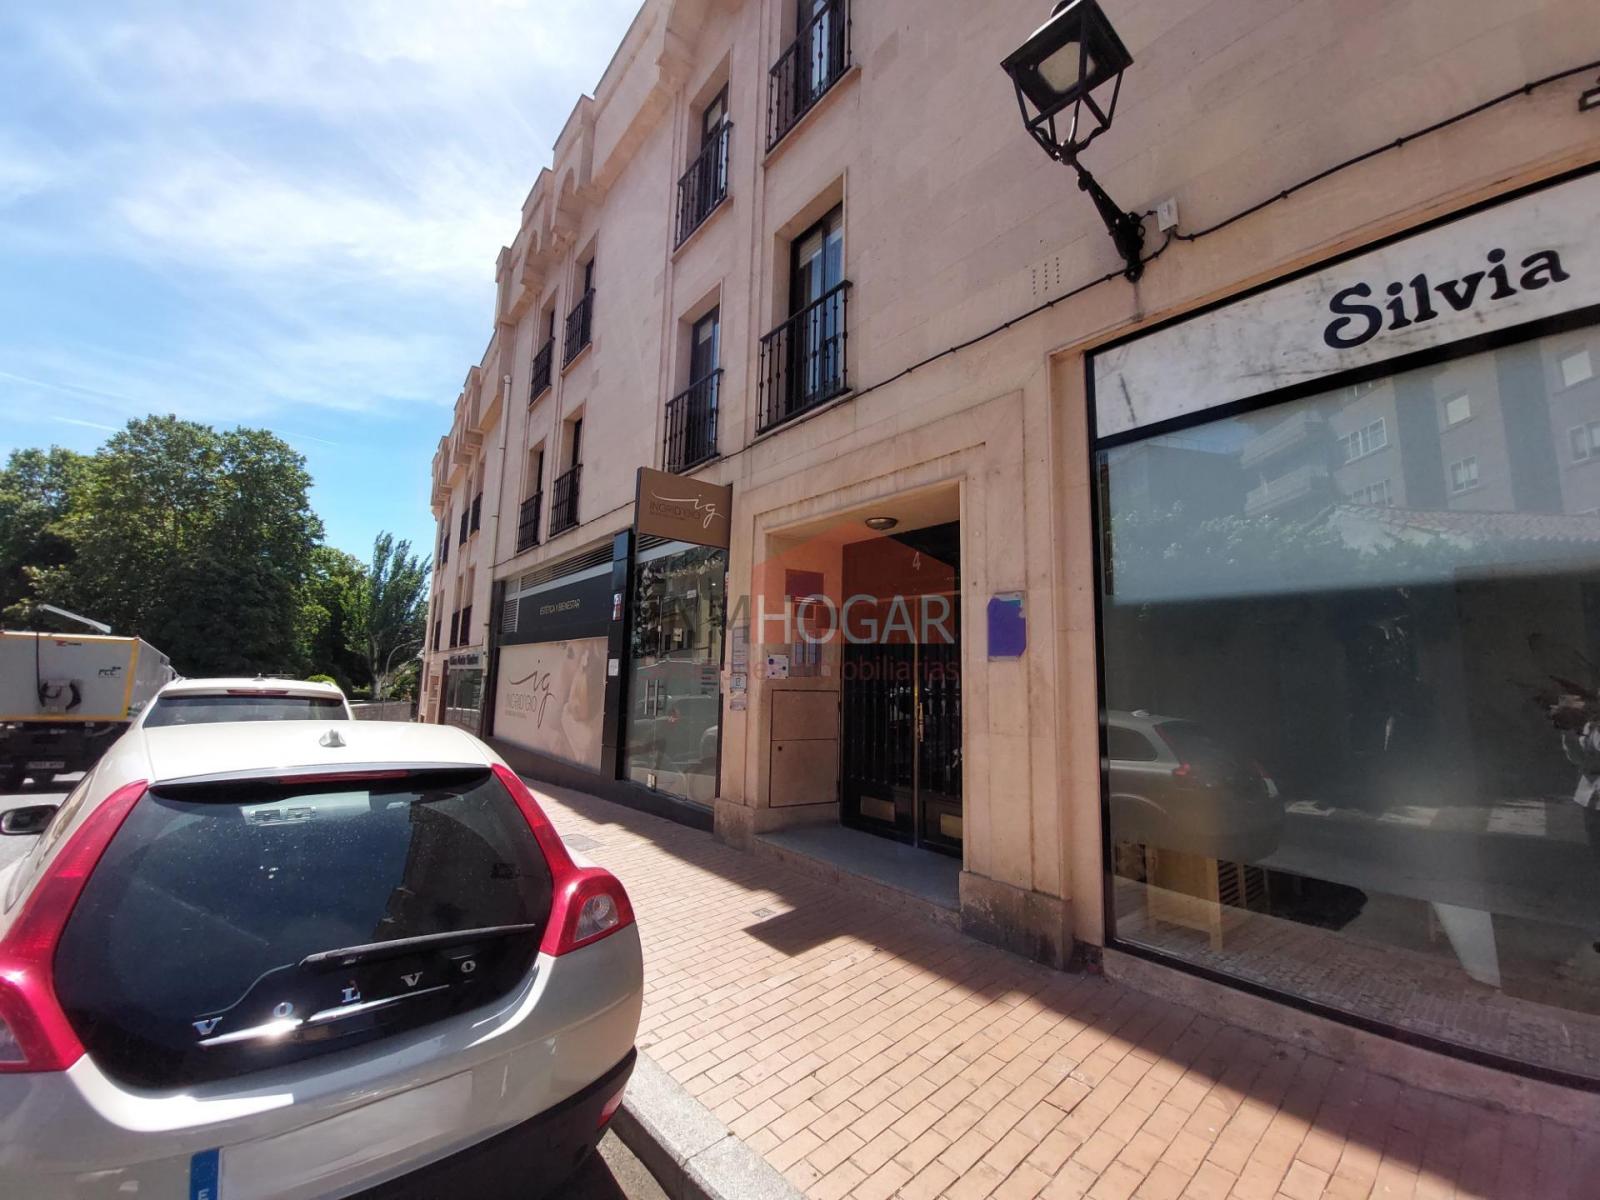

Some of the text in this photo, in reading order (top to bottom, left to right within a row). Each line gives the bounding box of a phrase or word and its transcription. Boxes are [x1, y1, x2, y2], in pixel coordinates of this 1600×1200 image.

[1323, 248, 1571, 349] Silvia
[912, 551, 921, 571] 4
[192, 960, 477, 1035] VOLVO
